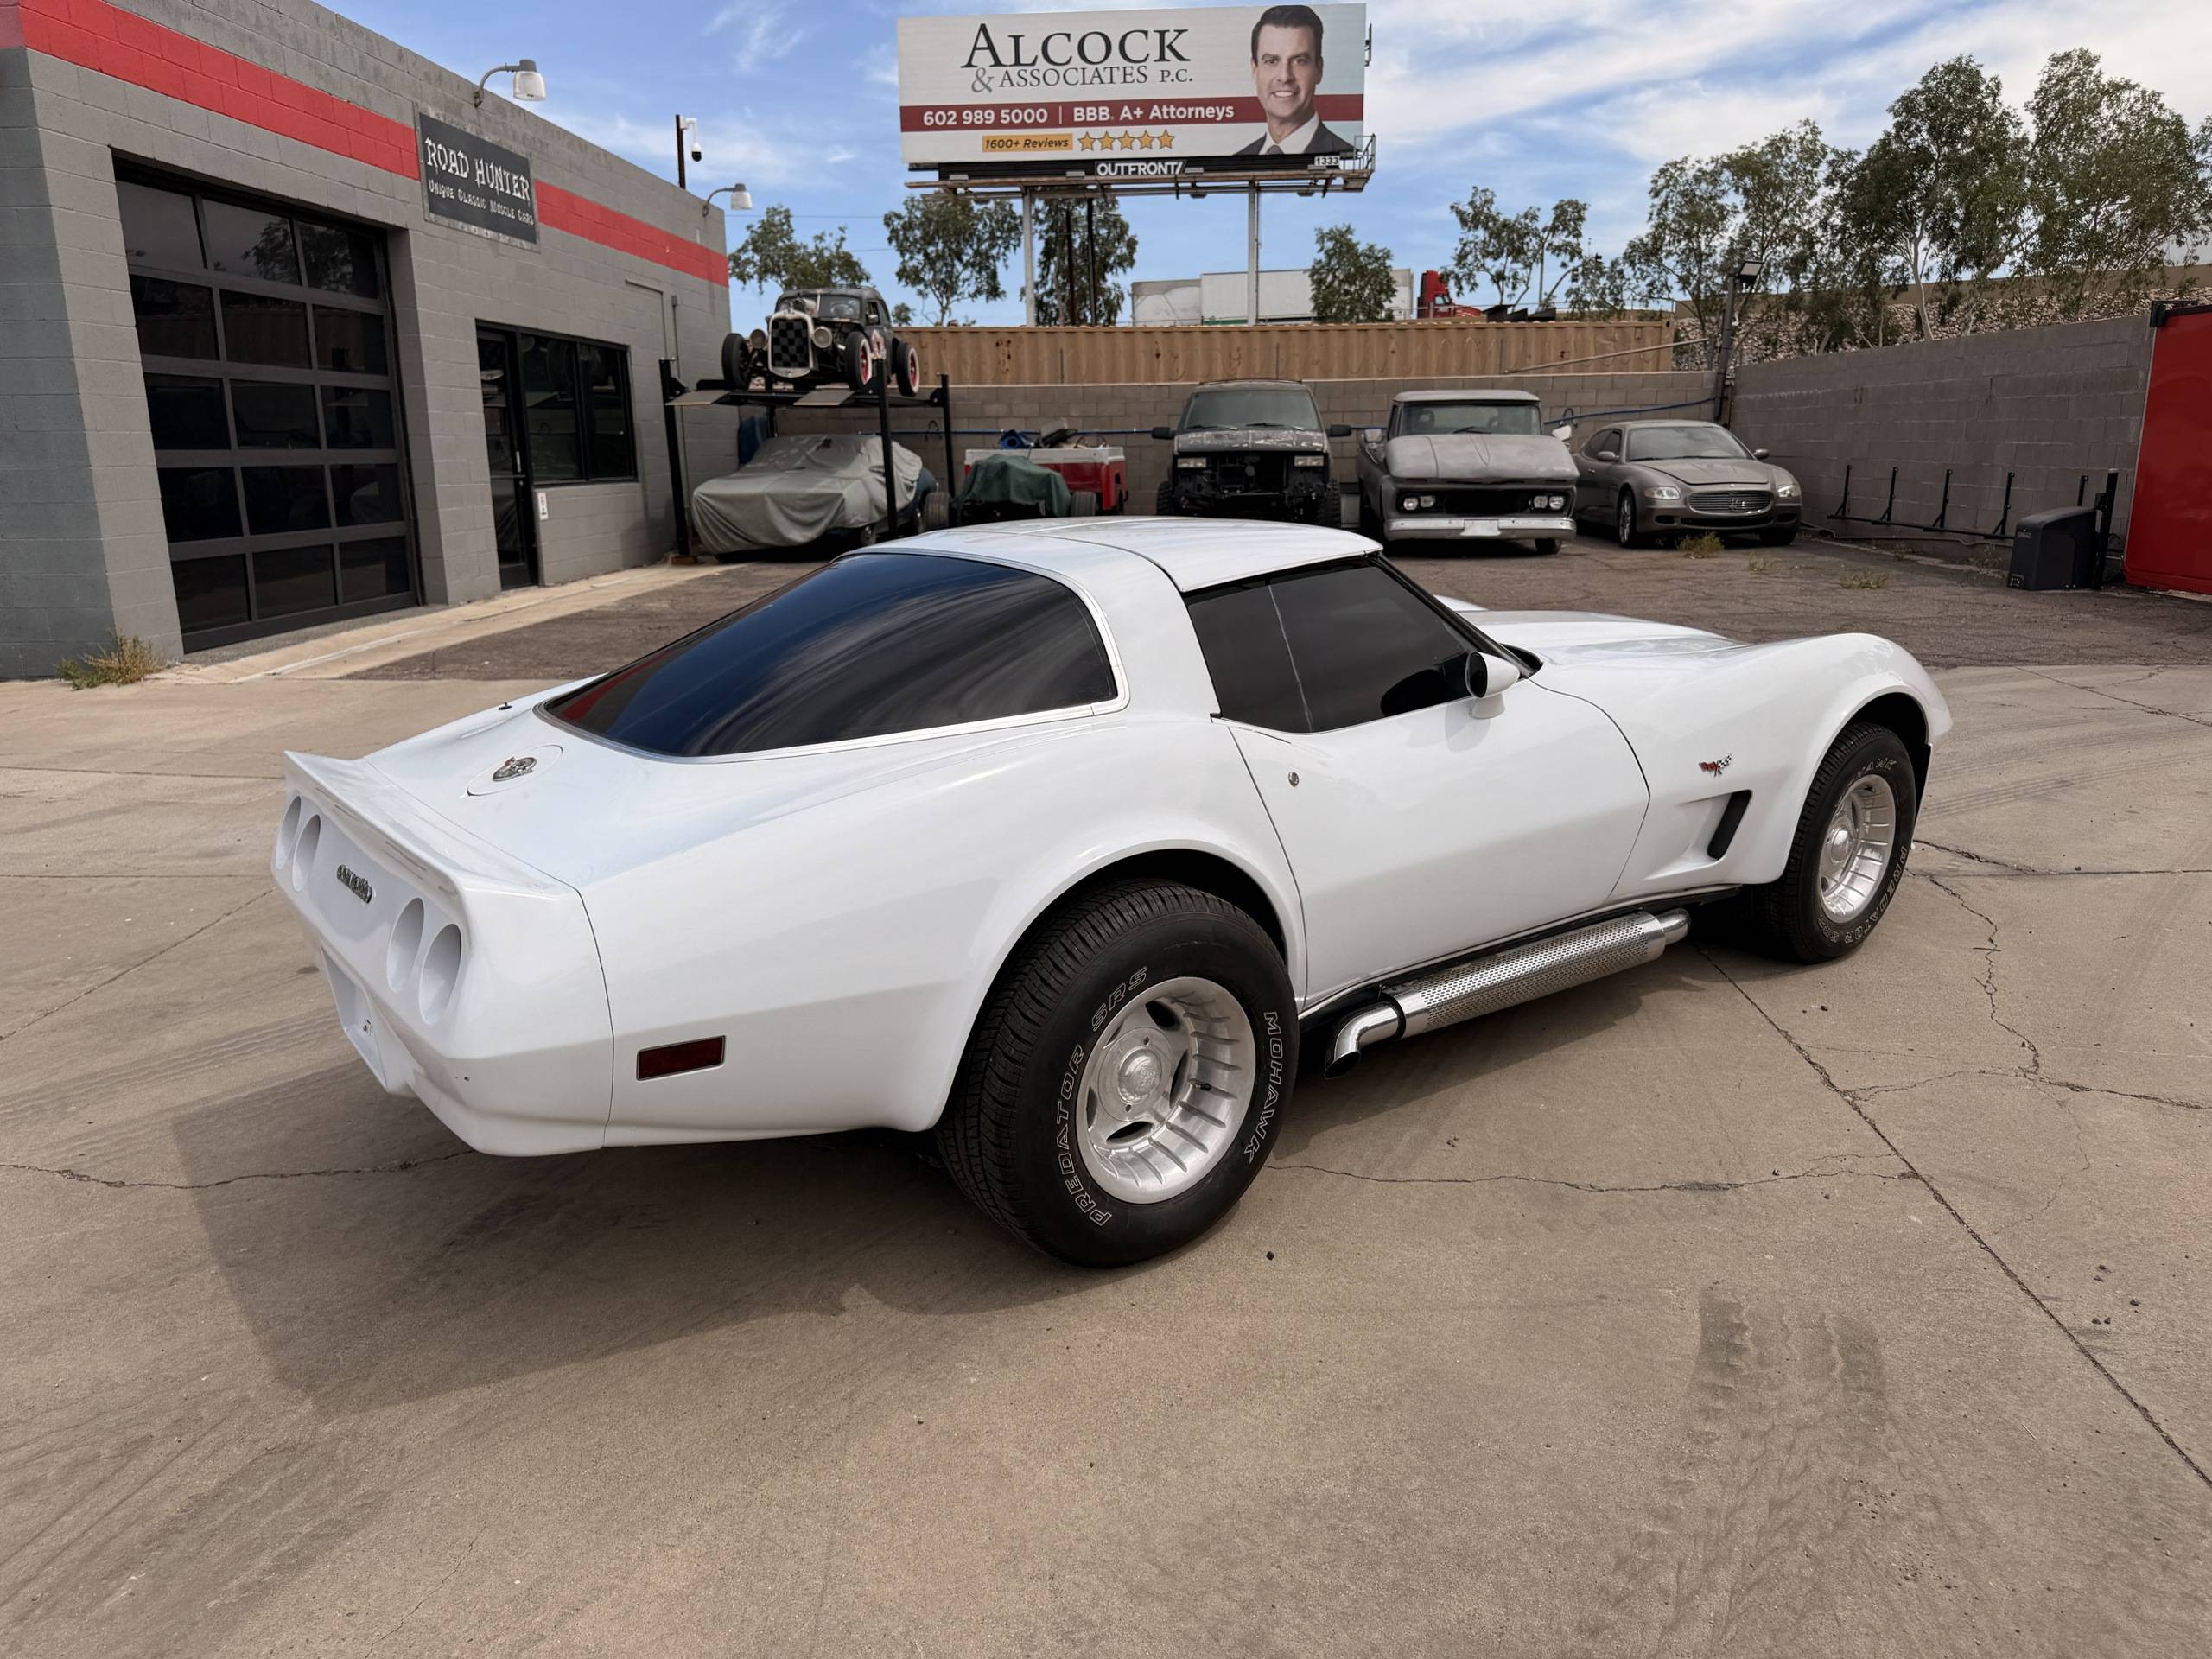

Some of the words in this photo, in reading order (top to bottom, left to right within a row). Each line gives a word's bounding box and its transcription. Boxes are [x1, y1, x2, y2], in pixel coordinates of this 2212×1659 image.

[960, 22, 1192, 68] ALCOCK
[970, 67, 995, 93] &
[999, 65, 1148, 87] ASSOCIATES
[1159, 68, 1193, 84] P.C.
[923, 111, 957, 126] 602
[962, 109, 995, 125] 989
[1000, 108, 1048, 124] 5000
[1119, 105, 1144, 120] A+
[1148, 104, 1235, 120] Attorneys
[985, 139, 1020, 149] 1600+
[1023, 137, 1069, 149] Reviews
[424, 137, 470, 179] ROAD
[474, 157, 531, 205] HUNTER
[1056, 1044, 1112, 1227] PREDATOR
[1091, 967, 1147, 1032] SRS
[1243, 1011, 1284, 1164] MOHAWK
